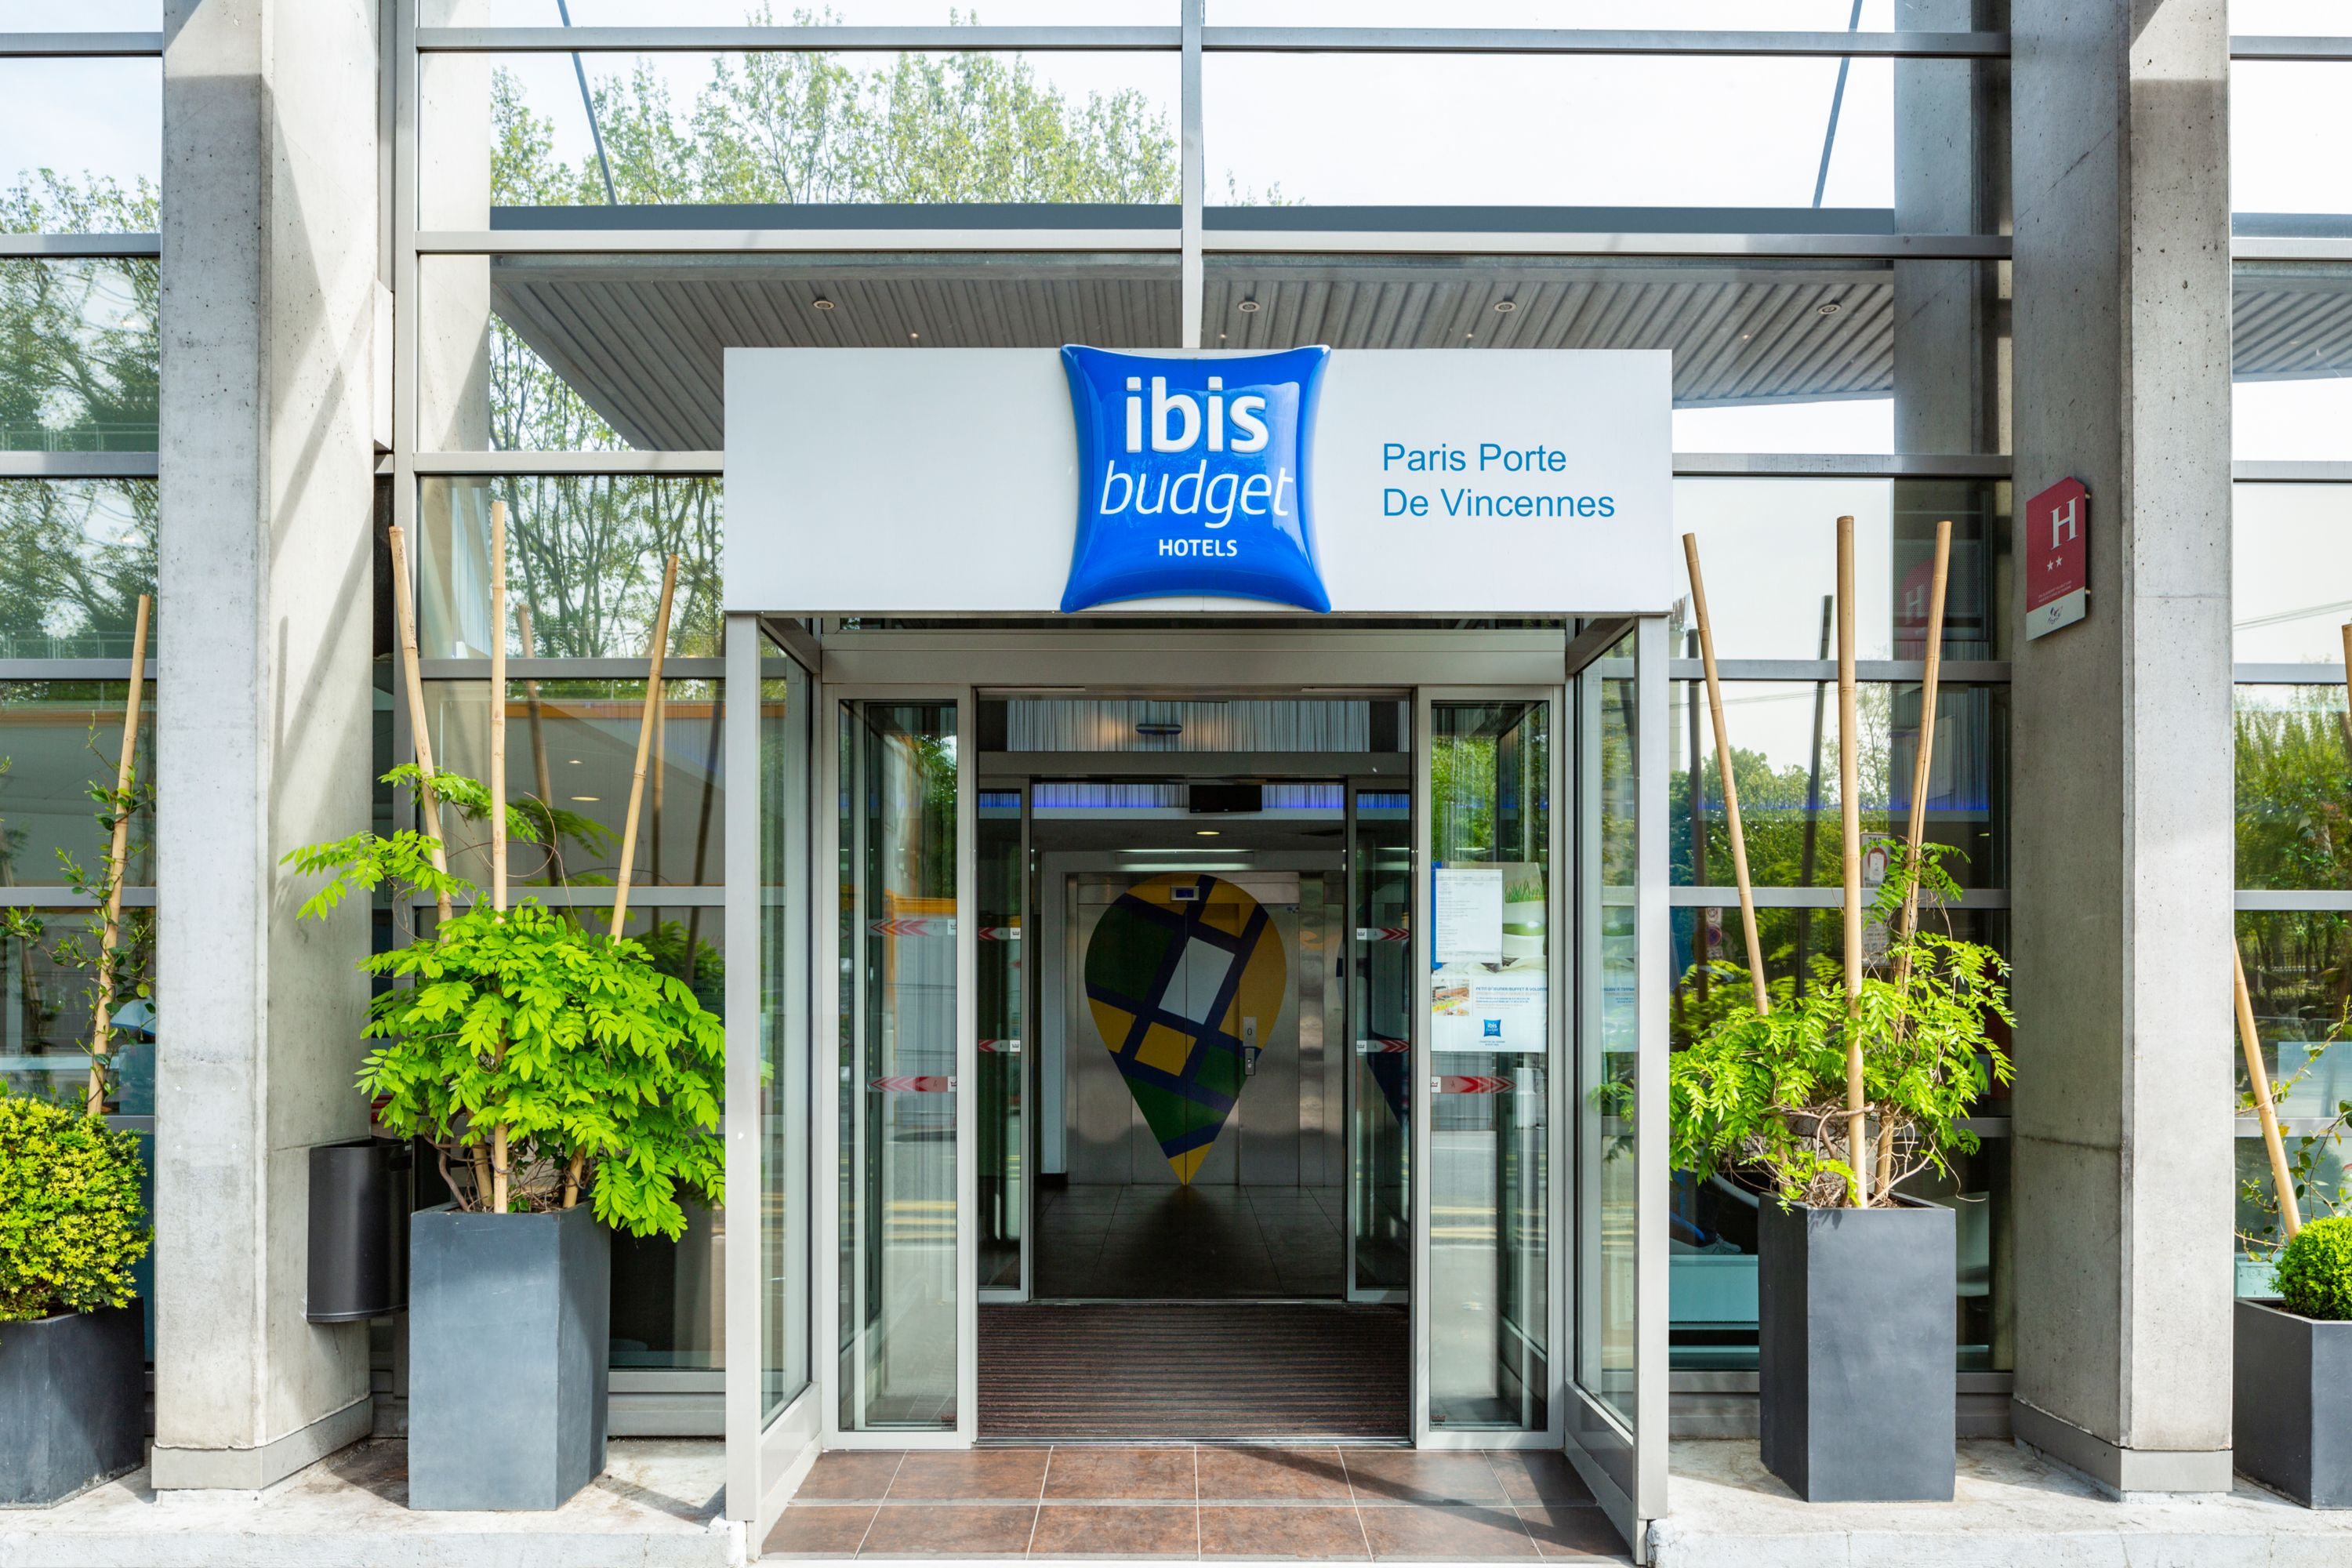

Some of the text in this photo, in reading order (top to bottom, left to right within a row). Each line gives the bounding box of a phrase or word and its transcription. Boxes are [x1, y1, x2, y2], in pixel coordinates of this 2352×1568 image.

[1126, 376, 1269, 453] ibis
[1384, 443, 1566, 472] Paris Porte
[1100, 459, 1294, 529] budget
[1384, 488, 1615, 517] De Vincennes
[2049, 495, 2078, 551] H
[1159, 539, 1238, 557] HOTELS
